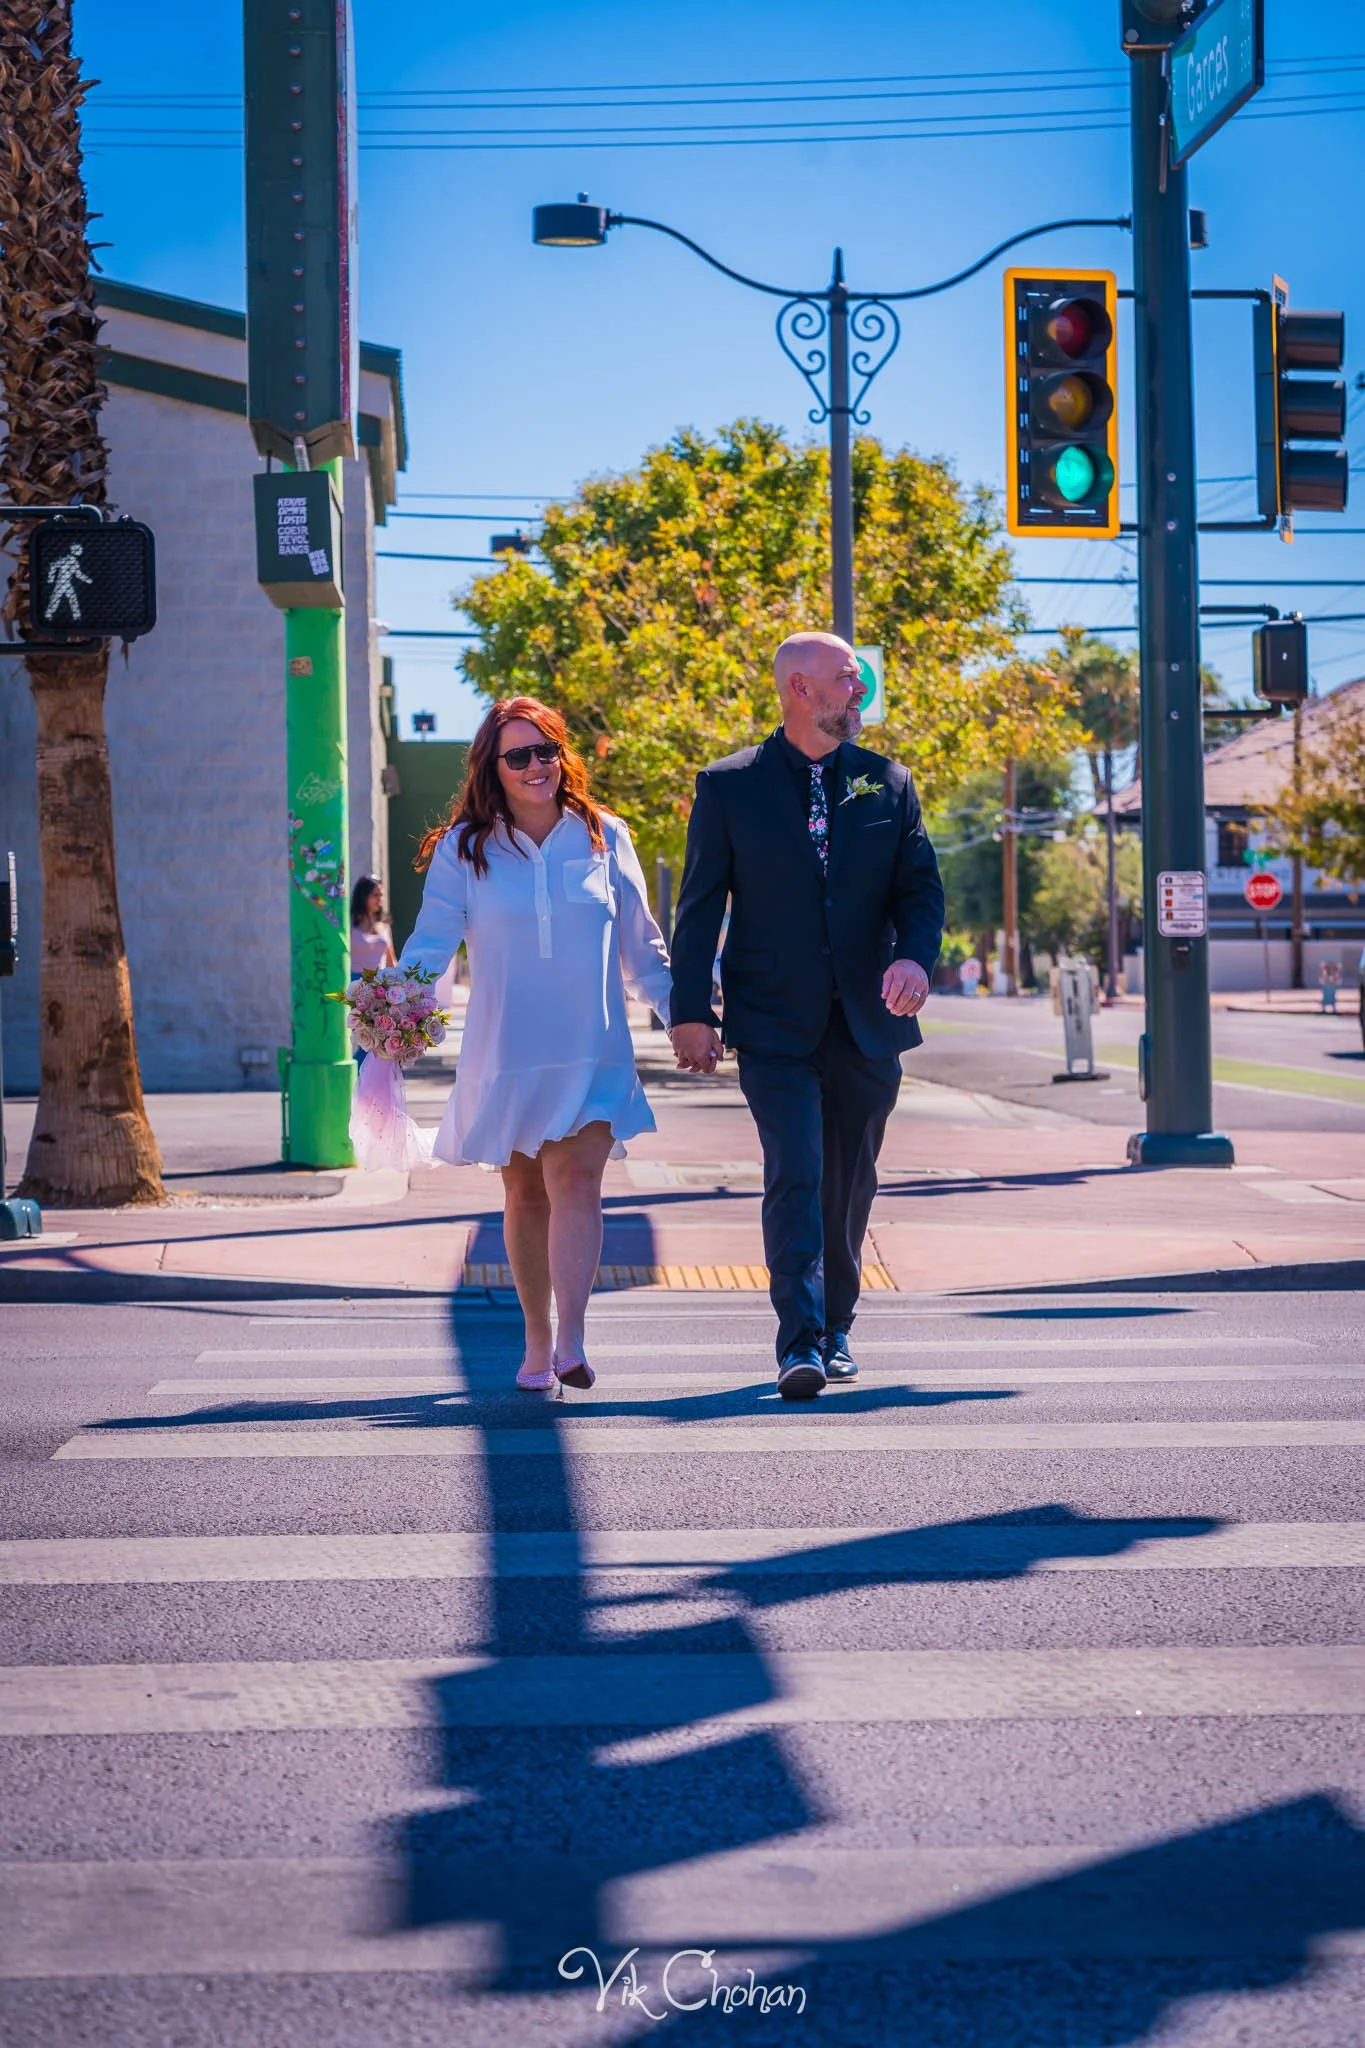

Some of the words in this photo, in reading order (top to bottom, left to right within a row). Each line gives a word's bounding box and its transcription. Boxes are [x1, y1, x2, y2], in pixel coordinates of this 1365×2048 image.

[1187, 35, 1229, 121] Garces
[279, 545, 310, 555] BANGS
[1249, 883, 1276, 898] STOP
